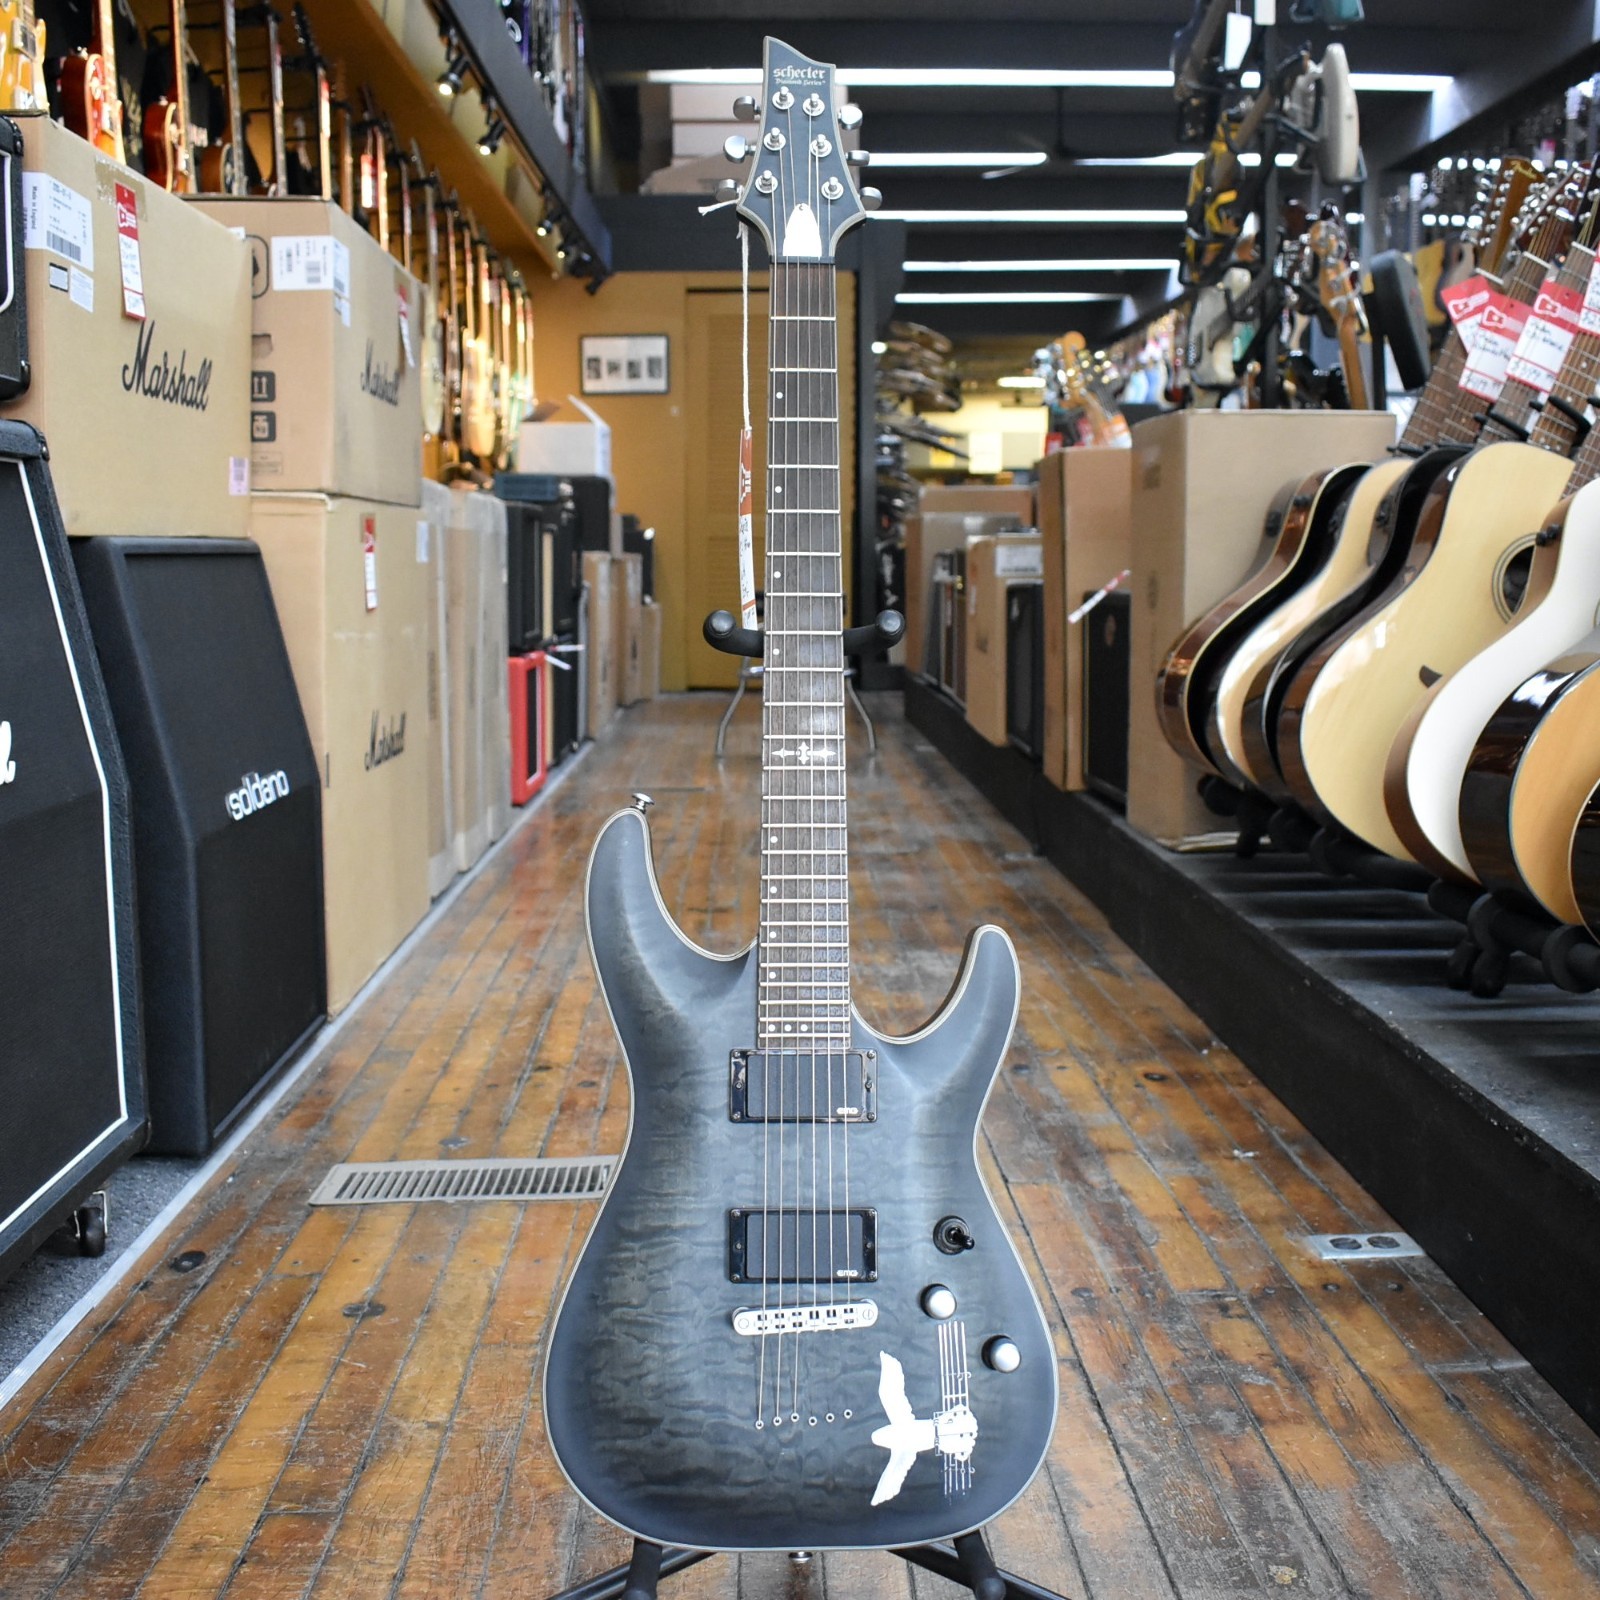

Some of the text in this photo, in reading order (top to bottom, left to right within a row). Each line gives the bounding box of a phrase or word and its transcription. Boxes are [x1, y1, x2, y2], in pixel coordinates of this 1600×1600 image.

[773, 65, 826, 80] schecter
[122, 319, 212, 412] Marshall
[227, 770, 290, 821] soldano
